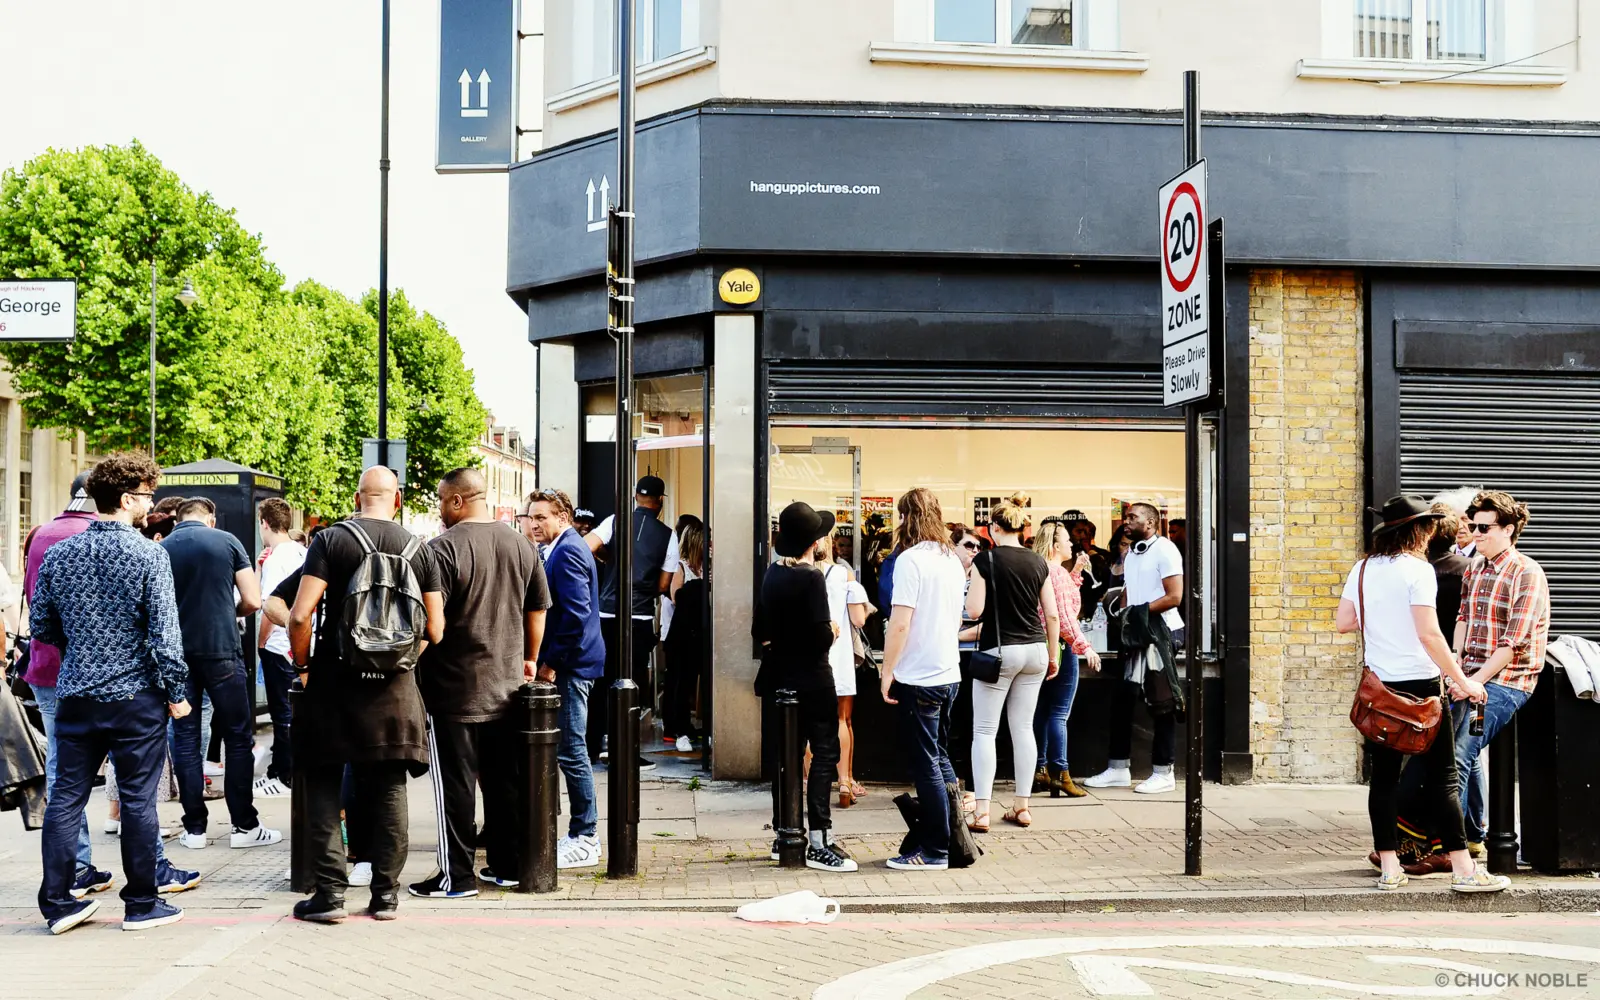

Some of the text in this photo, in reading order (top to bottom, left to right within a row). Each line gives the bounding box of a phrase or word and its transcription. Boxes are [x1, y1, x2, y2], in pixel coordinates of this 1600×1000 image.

[750, 181, 880, 194] hanguppictures.com
[1170, 212, 1195, 263] 20
[727, 281, 753, 292] Yale
[0, 298, 60, 315] George
[1168, 294, 1201, 331] ZONE
[1165, 346, 1205, 371] Please Drive
[1171, 369, 1200, 394] Slowly
[165, 475, 228, 485] TELEPHONE
